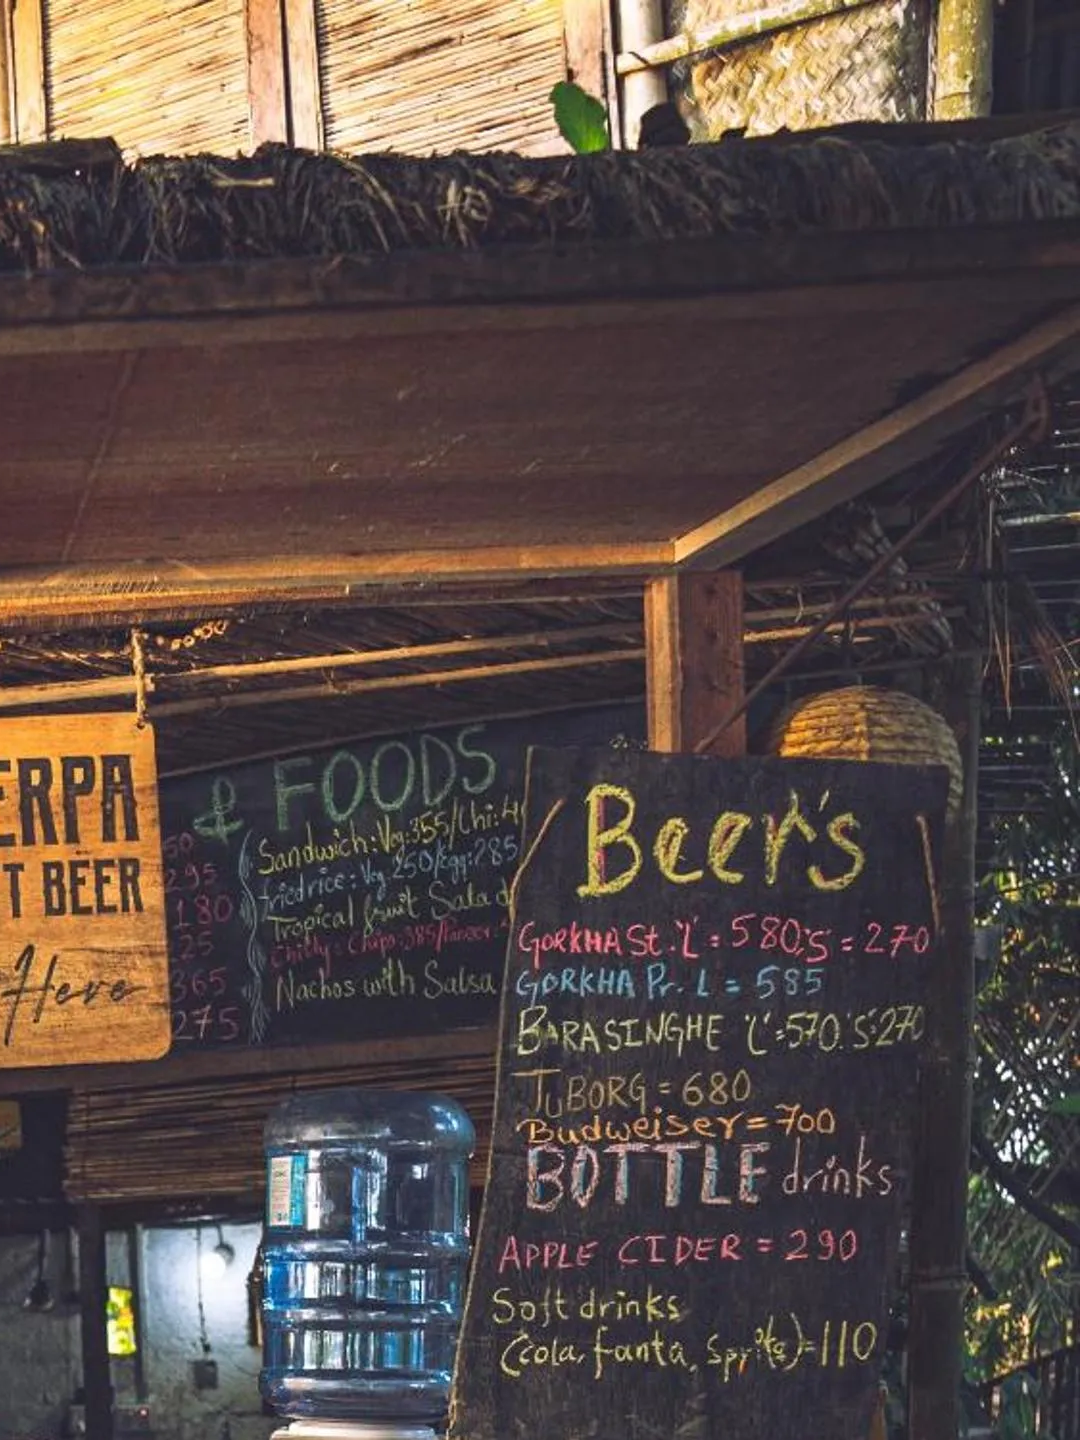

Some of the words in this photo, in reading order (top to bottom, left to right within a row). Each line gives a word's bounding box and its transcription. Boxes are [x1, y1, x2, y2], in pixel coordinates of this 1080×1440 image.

[274, 725, 497, 831] FOODS
[577, 783, 866, 900] Beer's
[42, 857, 145, 918] BEER
[518, 919, 620, 969] GORKHA
[863, 921, 930, 958] 270
[1, 943, 148, 1048] Here
[276, 966, 356, 1013] Nachos
[363, 956, 416, 999] with
[423, 959, 498, 1000] Salsa
[516, 966, 635, 1010] GORKHA
[756, 964, 825, 999] 585
[172, 1003, 241, 1041] 275
[681, 1070, 752, 1107] 680
[516, 1108, 741, 1146] Budweiser
[773, 1102, 836, 1138] 700
[525, 1140, 773, 1212] BOTTLE
[782, 1134, 896, 1199] drinks
[498, 1234, 598, 1274] APPLE
[618, 1233, 744, 1267] CIDER
[783, 1229, 858, 1262] 290
[491, 1286, 571, 1328] Soft
[579, 1283, 683, 1321] drinks
